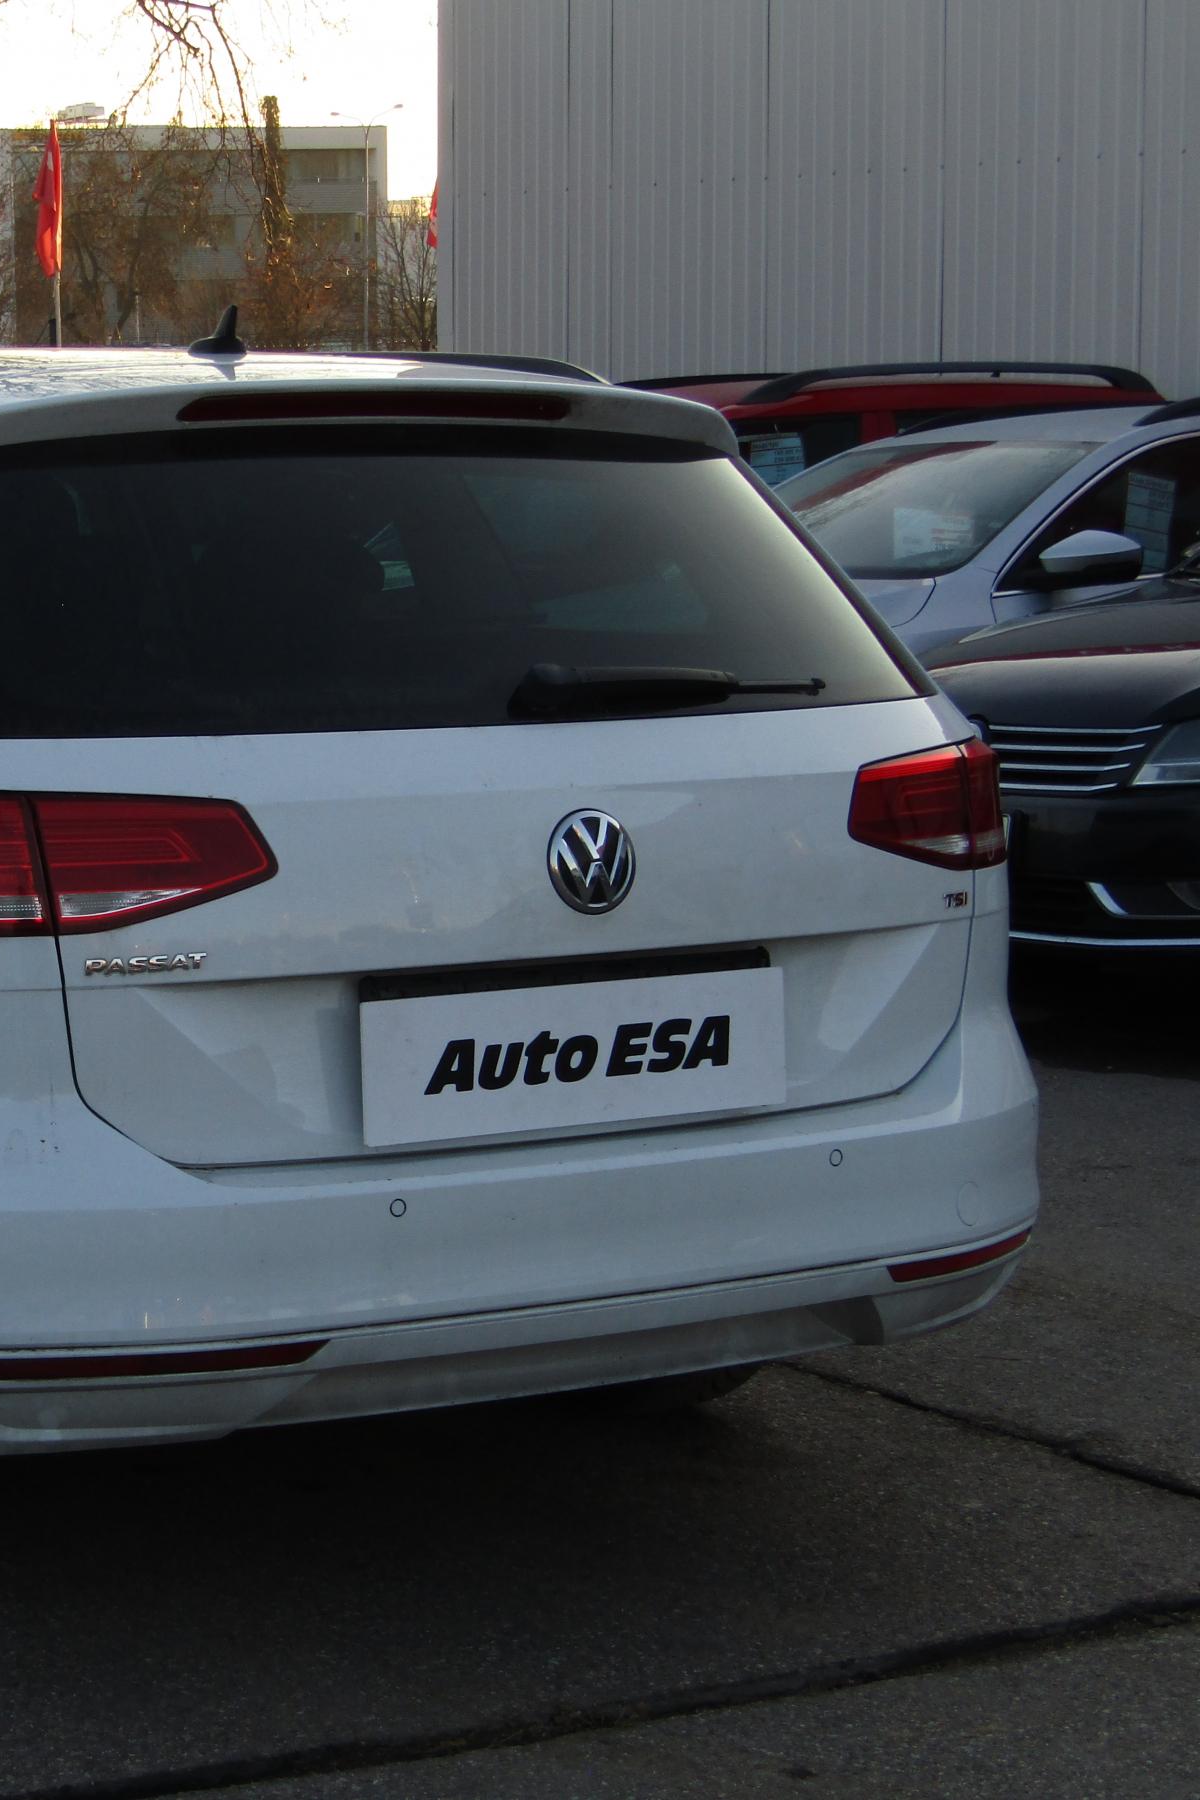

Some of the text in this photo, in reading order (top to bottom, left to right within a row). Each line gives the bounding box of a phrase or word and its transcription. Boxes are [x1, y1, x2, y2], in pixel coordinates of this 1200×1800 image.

[84, 952, 207, 976] PASSAT
[423, 1014, 731, 1096] Auto ESA
